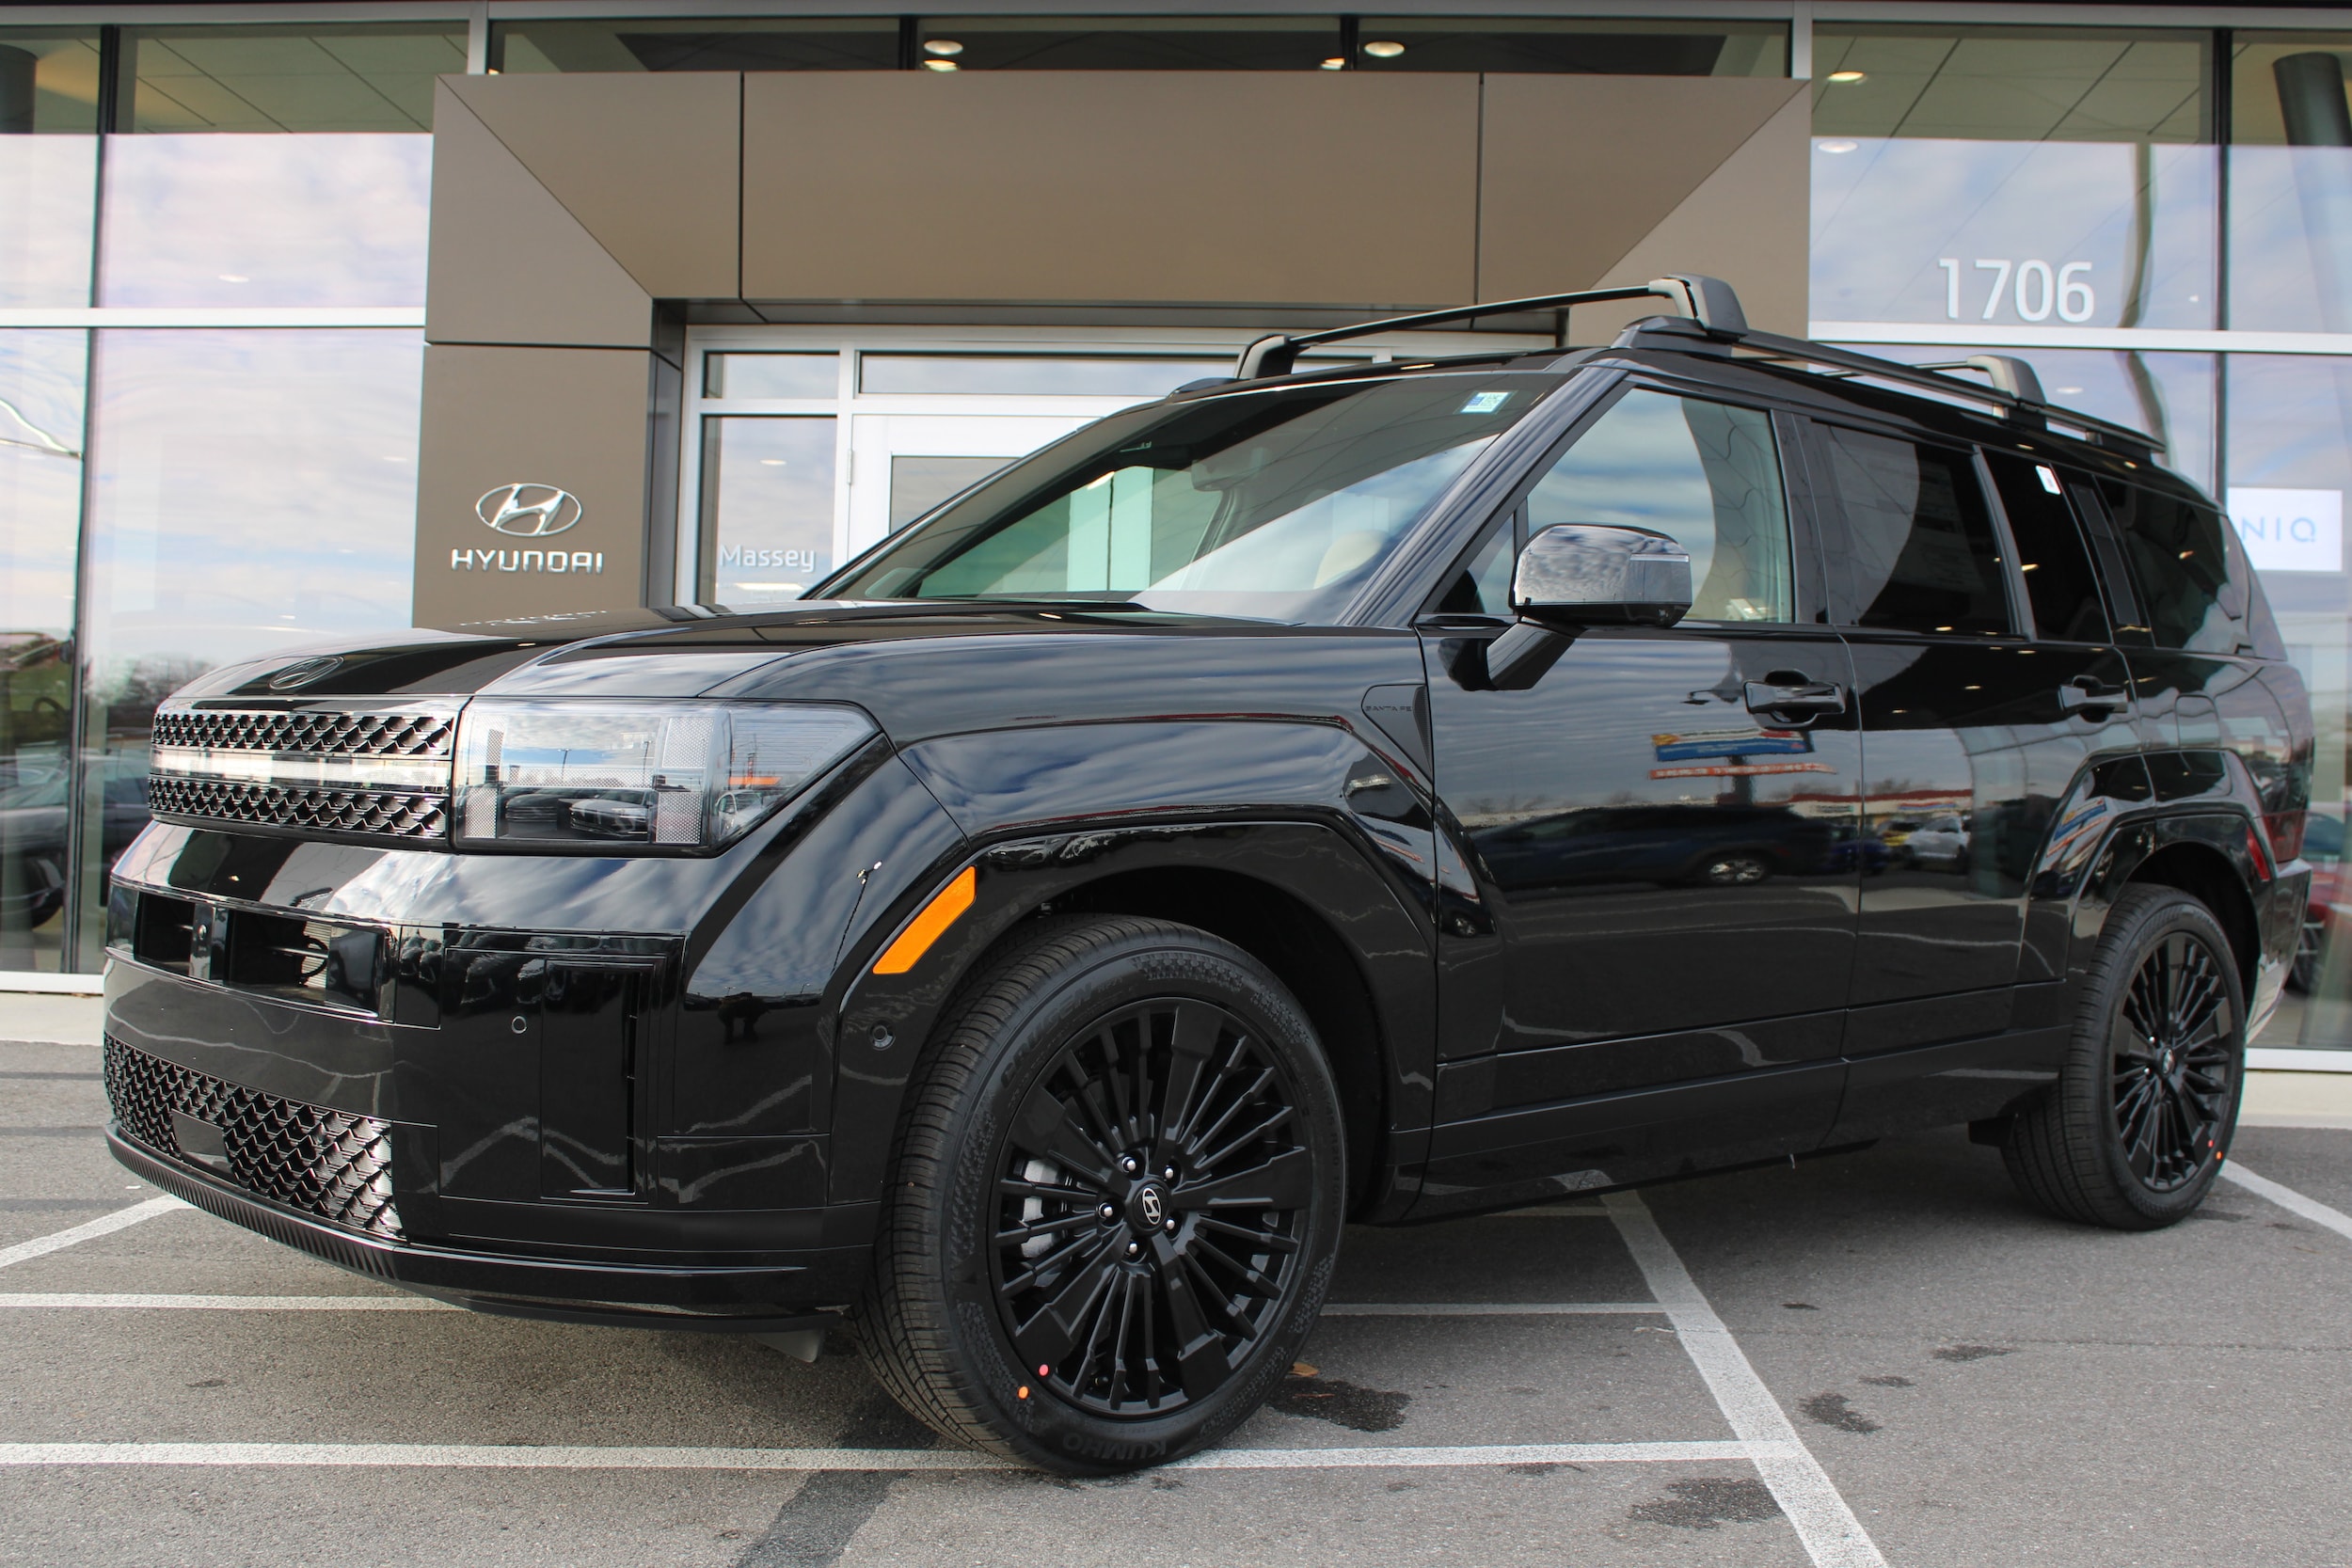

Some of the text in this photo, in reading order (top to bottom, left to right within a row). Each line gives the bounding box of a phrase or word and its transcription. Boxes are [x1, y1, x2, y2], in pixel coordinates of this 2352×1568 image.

[1938, 258, 2095, 323] 1706
[2241, 515, 2316, 543] NIQ
[451, 548, 603, 573] HYUNDAI
[720, 544, 816, 573] Massey
[1062, 1432, 1168, 1461] KUMHO
